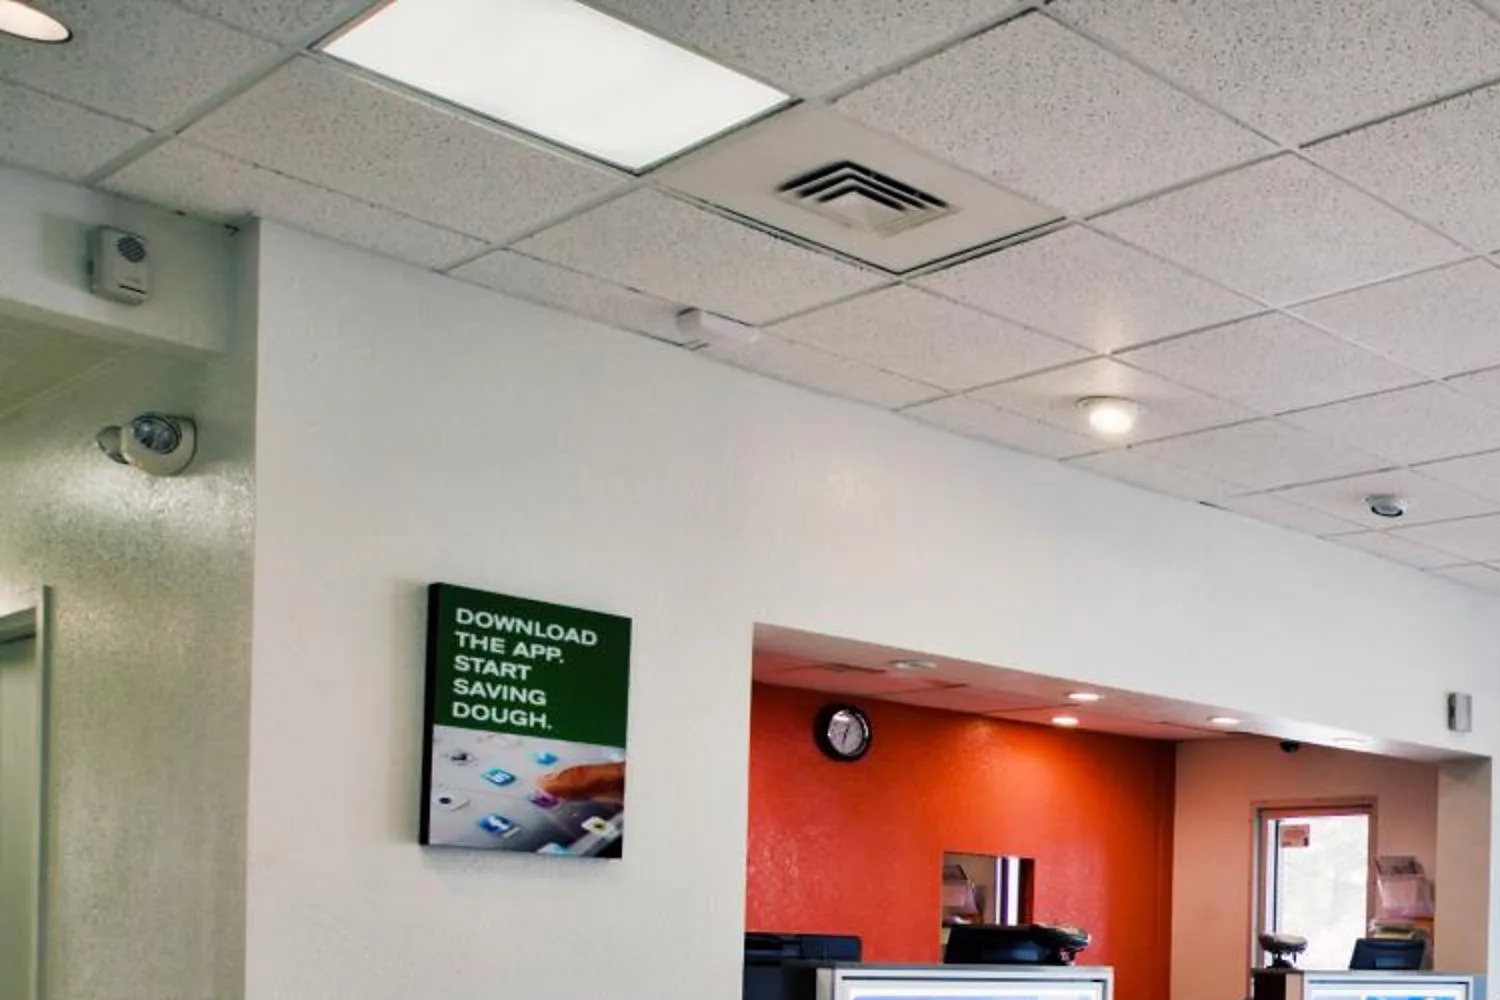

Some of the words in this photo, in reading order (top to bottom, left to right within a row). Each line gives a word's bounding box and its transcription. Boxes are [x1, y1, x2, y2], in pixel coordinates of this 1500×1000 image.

[456, 608, 598, 645] DOWNLOAD
[455, 631, 505, 654] THE
[512, 641, 564, 663] APP.
[454, 655, 532, 680] START
[453, 678, 547, 706] SAVING
[452, 702, 552, 729] DOUGH.
